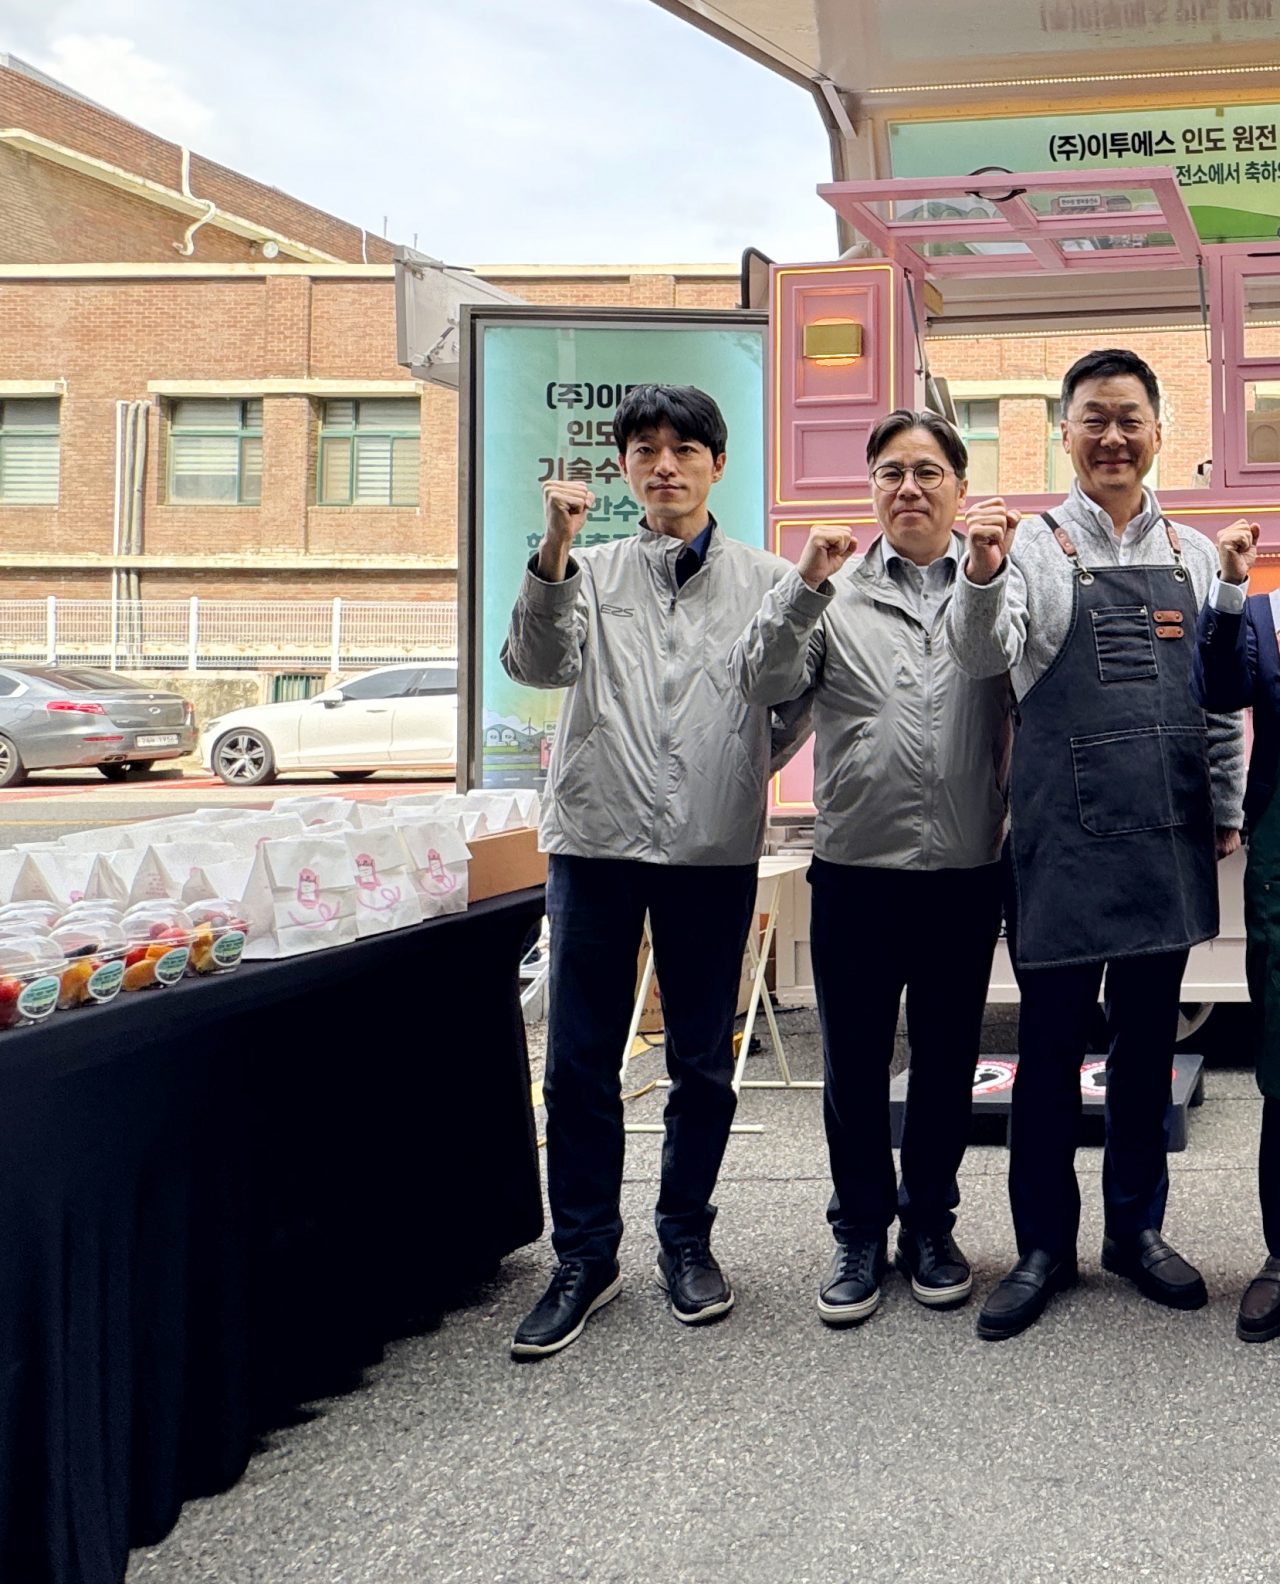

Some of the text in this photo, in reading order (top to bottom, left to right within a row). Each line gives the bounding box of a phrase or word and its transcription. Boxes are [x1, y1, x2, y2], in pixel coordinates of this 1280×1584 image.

[1049, 131, 1177, 162] (주)이투에스
[1181, 127, 1227, 154] 인도
[1232, 124, 1277, 152] 원전
[1175, 162, 1240, 187] 전소에서
[546, 382, 634, 410] (주)이
[538, 457, 623, 484] 기술수
